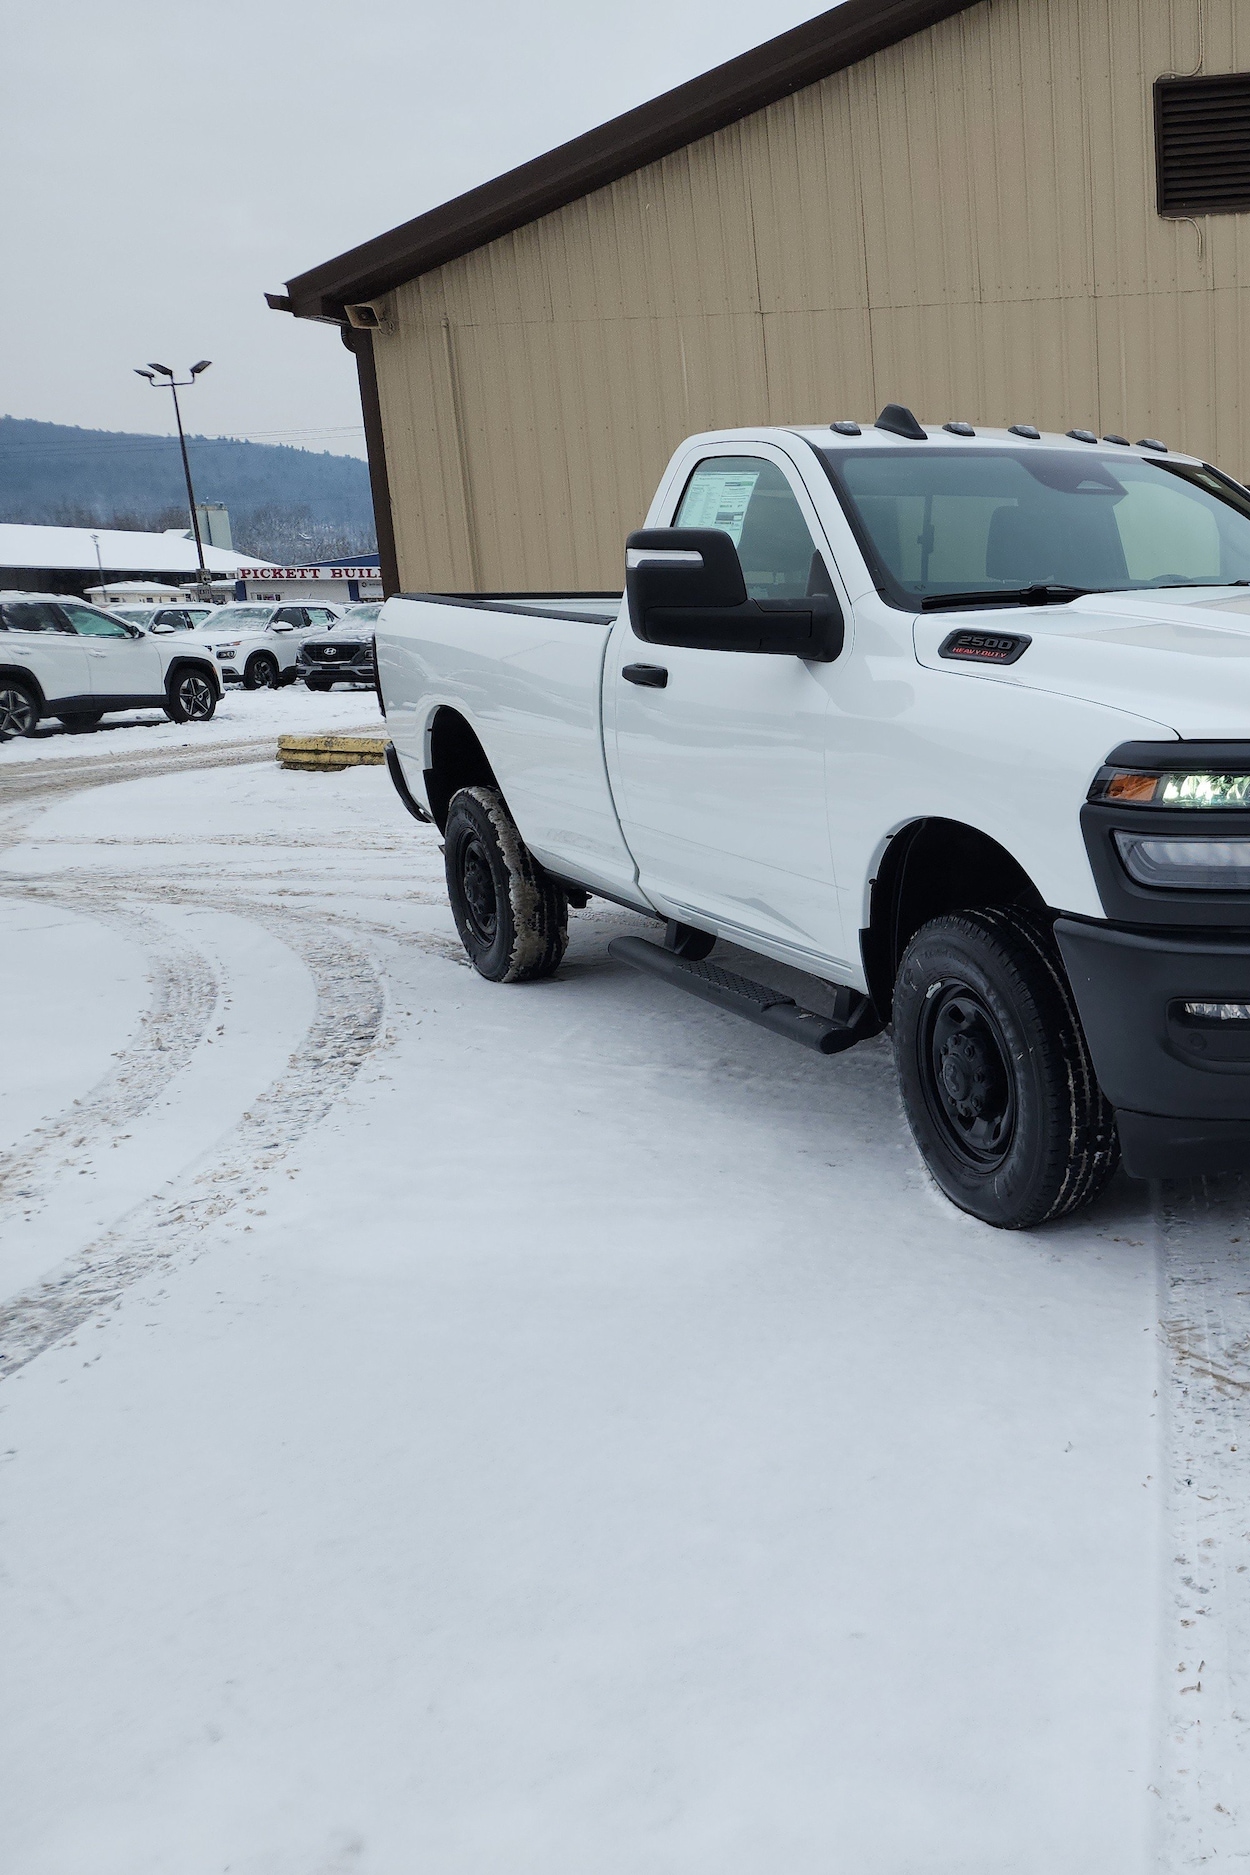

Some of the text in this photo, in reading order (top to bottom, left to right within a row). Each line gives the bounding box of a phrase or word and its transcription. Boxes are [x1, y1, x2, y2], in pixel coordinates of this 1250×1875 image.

[240, 568, 382, 579] PICKETT BUIL
[958, 635, 1013, 650] 2500
[952, 647, 1007, 658] HEAVY DUTY
